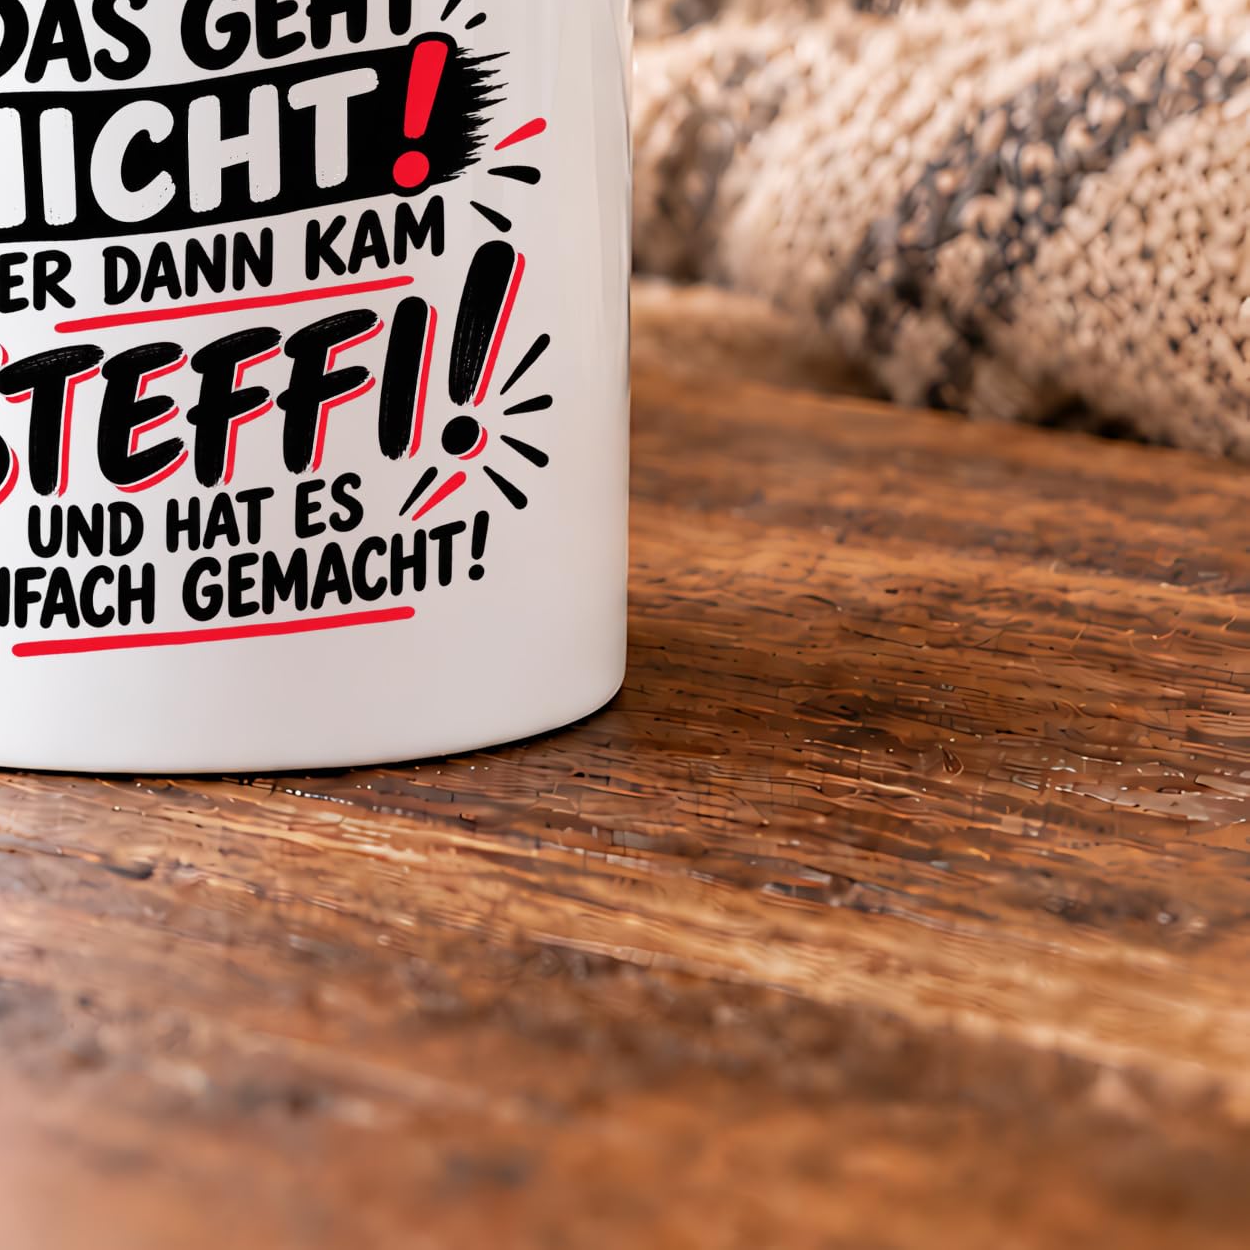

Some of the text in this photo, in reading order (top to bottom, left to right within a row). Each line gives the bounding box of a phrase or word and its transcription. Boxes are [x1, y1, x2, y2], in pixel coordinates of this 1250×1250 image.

[103, 227, 273, 305] DANN
[305, 195, 444, 280] KAM
[28, 472, 363, 558] UND HAT ES
[182, 511, 490, 621] GEMACHT!
